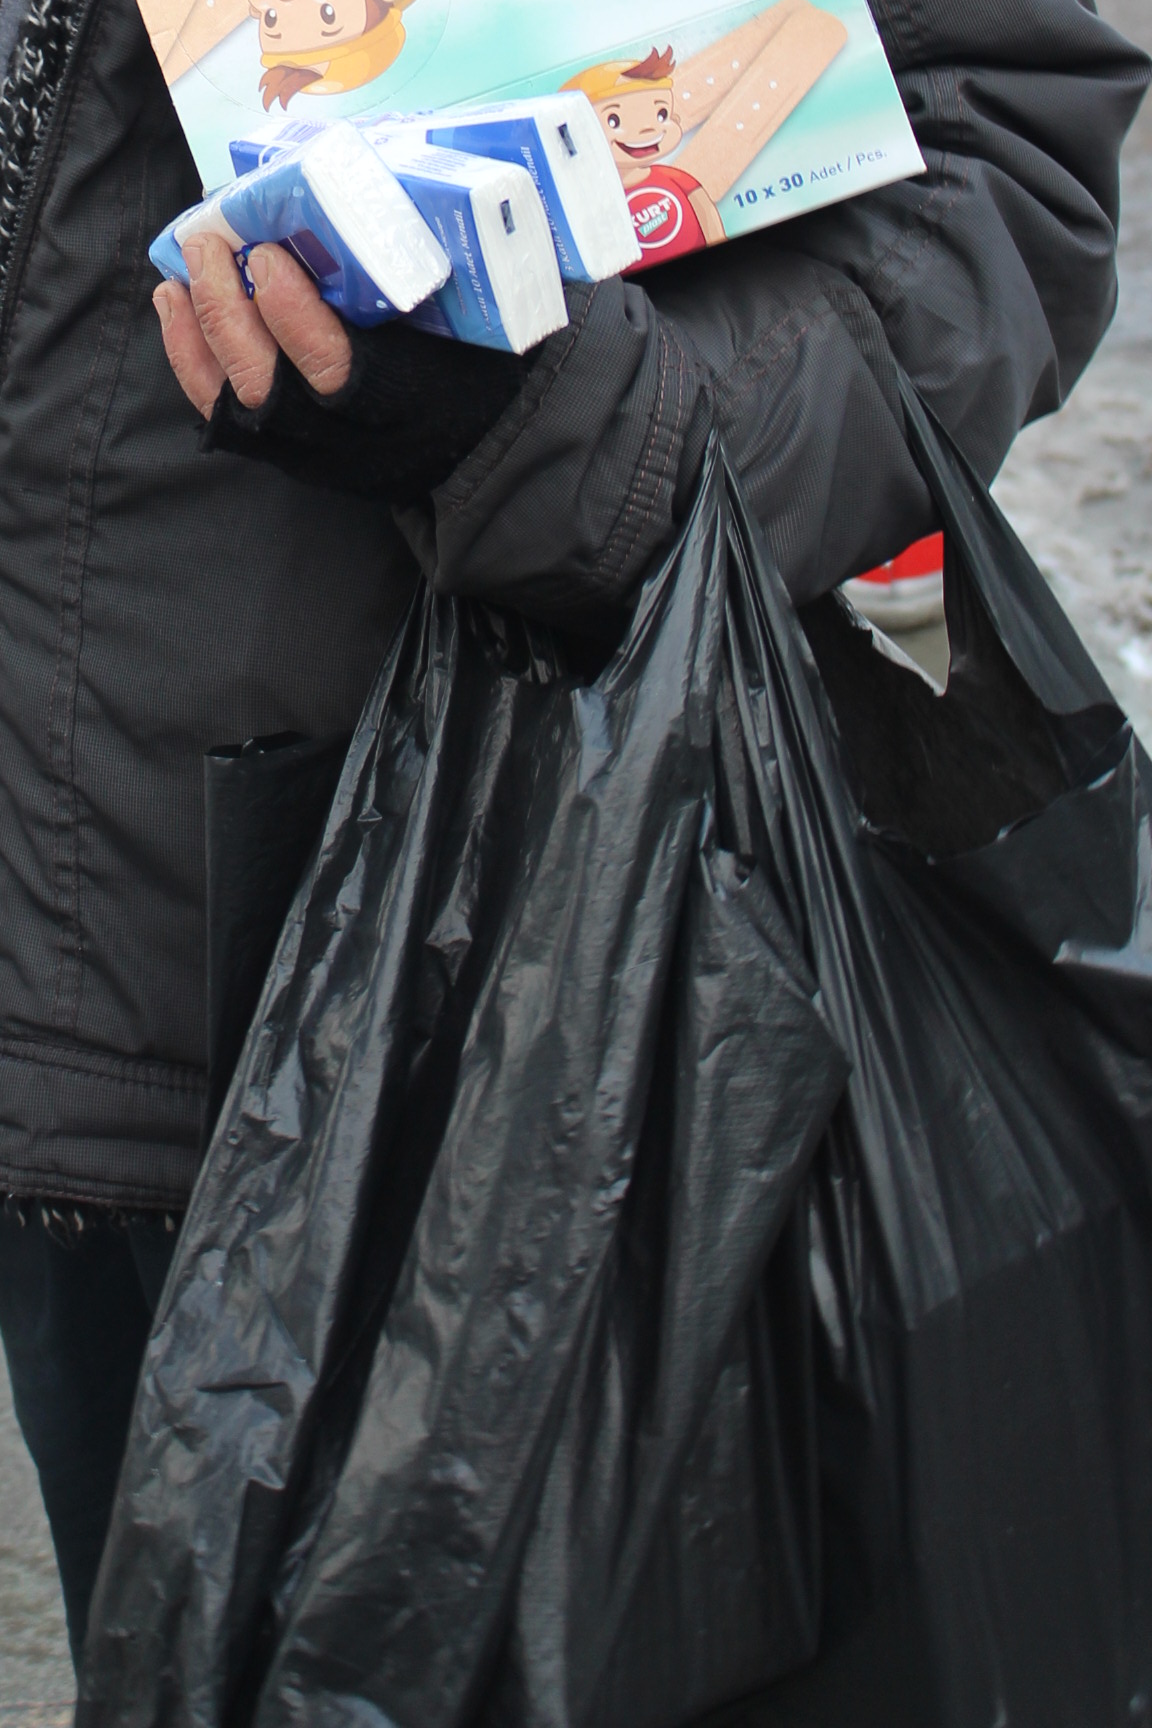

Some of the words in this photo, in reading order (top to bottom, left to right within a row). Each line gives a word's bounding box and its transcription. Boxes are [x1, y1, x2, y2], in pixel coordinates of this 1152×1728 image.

[733, 189, 758, 209] 10
[762, 185, 776, 200] x
[779, 173, 804, 192] 30
[809, 161, 844, 184] Adet
[856, 148, 888, 167] Pcs.
[453, 208, 470, 250] Mendil
[464, 251, 478, 278] Adet
[471, 278, 483, 294] 10
